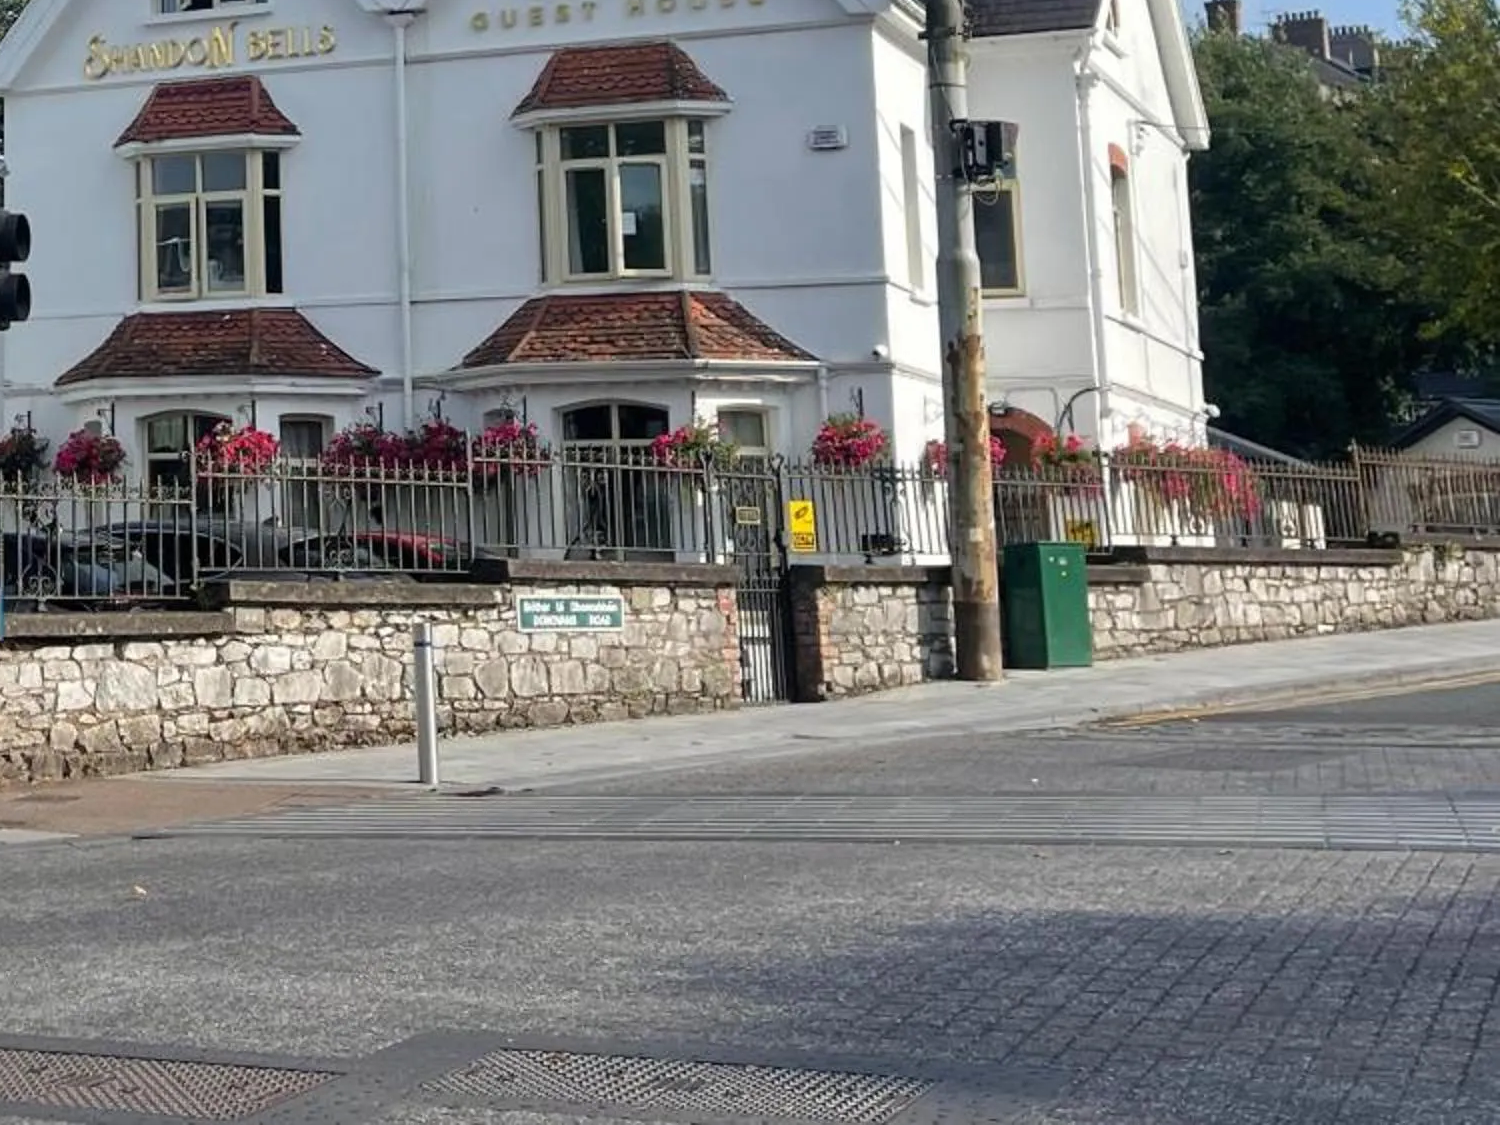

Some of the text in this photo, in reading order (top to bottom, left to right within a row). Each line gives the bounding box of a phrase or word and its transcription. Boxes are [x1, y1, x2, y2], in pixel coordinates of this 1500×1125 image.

[470, 1, 596, 33] GUEST
[83, 21, 337, 78] SHANDON BELLS
